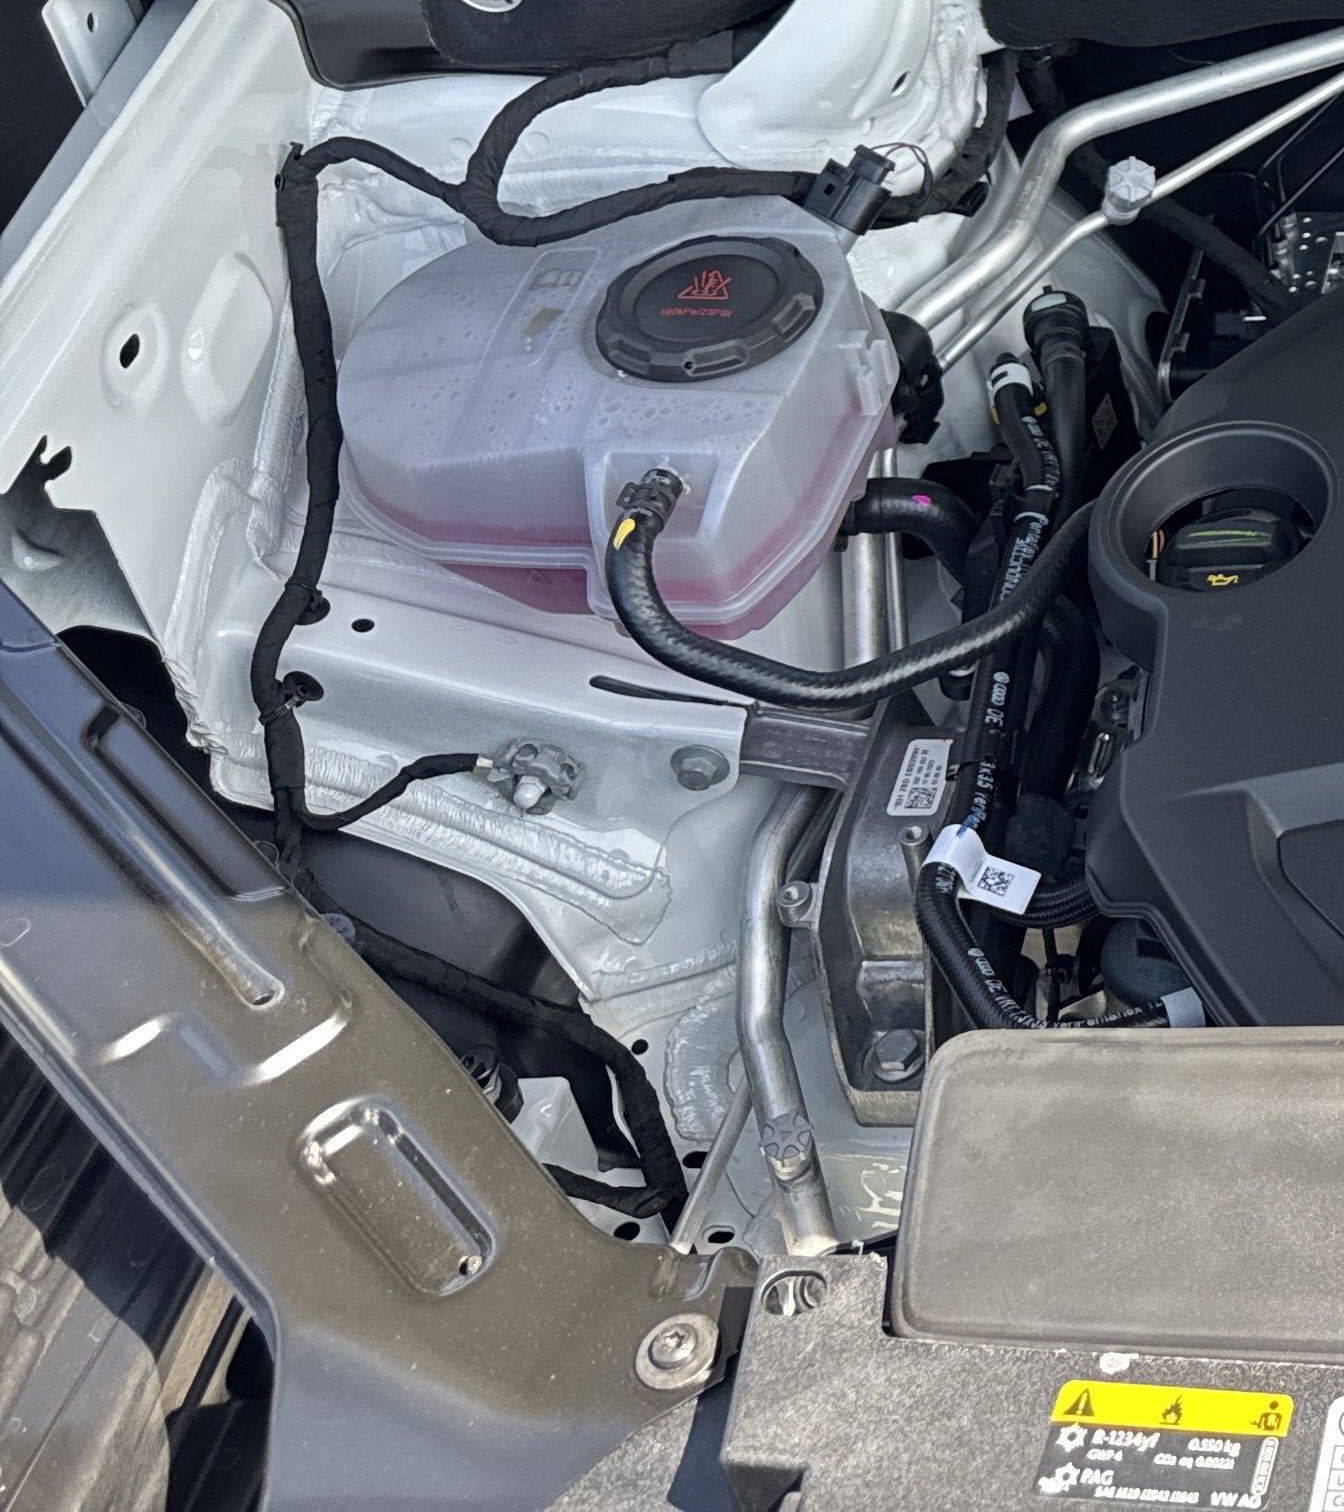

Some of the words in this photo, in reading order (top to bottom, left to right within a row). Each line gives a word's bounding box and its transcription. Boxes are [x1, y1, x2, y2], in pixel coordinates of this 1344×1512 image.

[1092, 1429, 1160, 1452] R-1234yf
[1080, 1468, 1115, 1485] PAG
[1209, 1491, 1238, 1507] VW
[1237, 1493, 1262, 1508] AG
